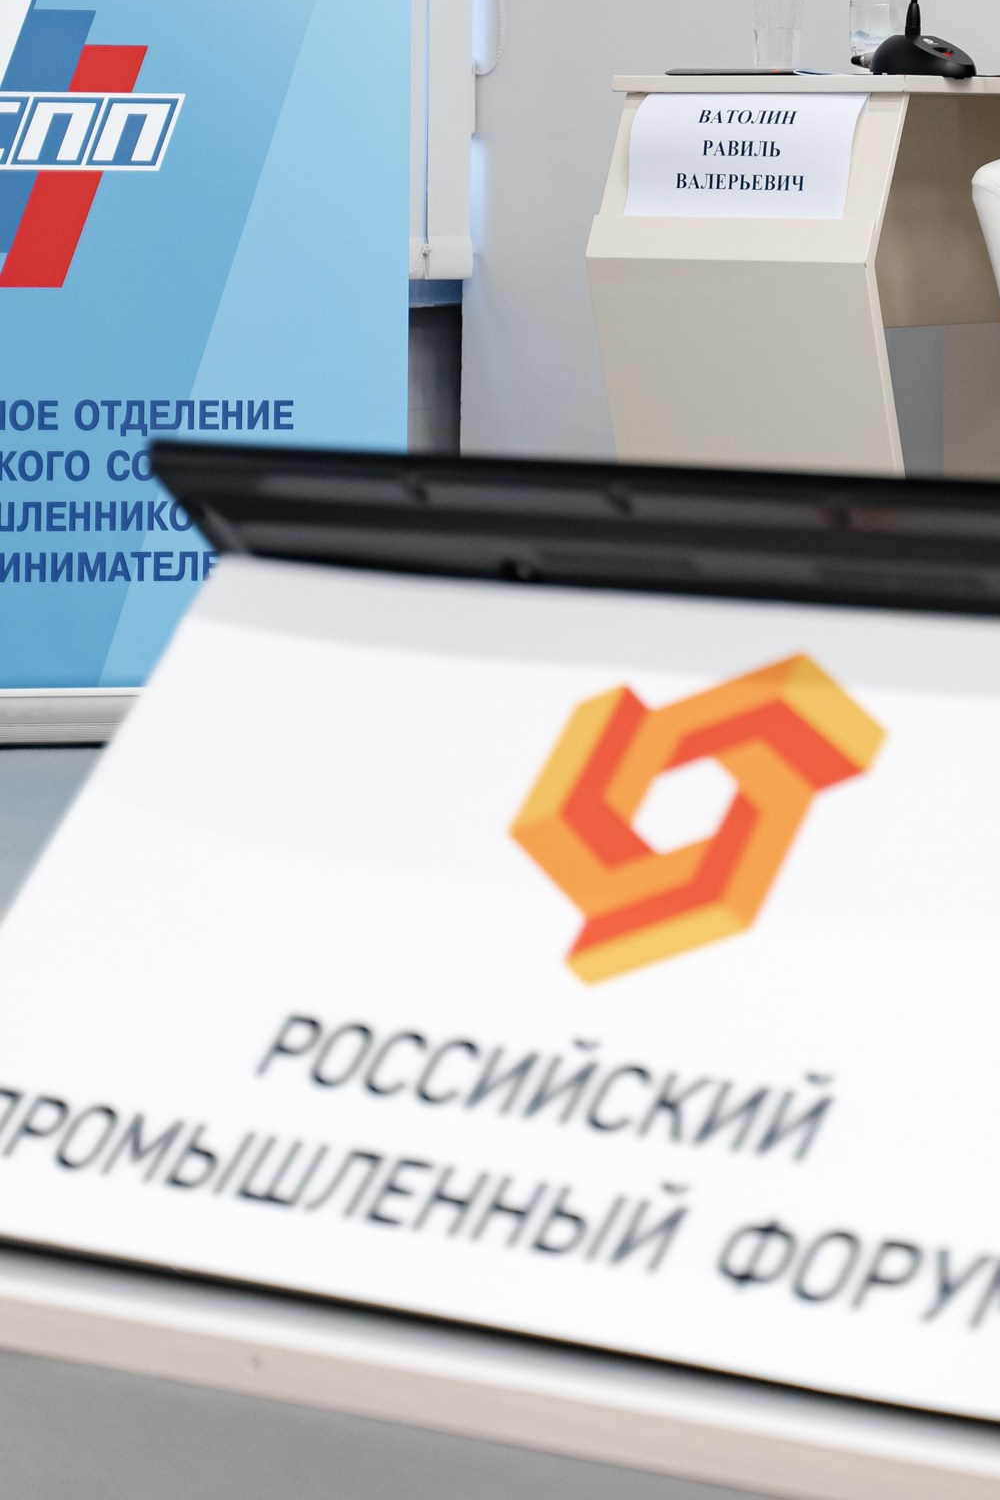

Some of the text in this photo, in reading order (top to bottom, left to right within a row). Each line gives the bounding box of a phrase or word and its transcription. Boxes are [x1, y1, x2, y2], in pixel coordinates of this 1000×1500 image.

[698, 109, 798, 125] ВАТОЛИН
[702, 140, 781, 157] РАВИЛЬ
[676, 173, 804, 191] ВАЛЕРЬЕВИЧ
[0, 399, 294, 436] ОЕ ОТДЕЛЕНИЕ
[256, 1013, 835, 1162] РОССИЙСКИЙ
